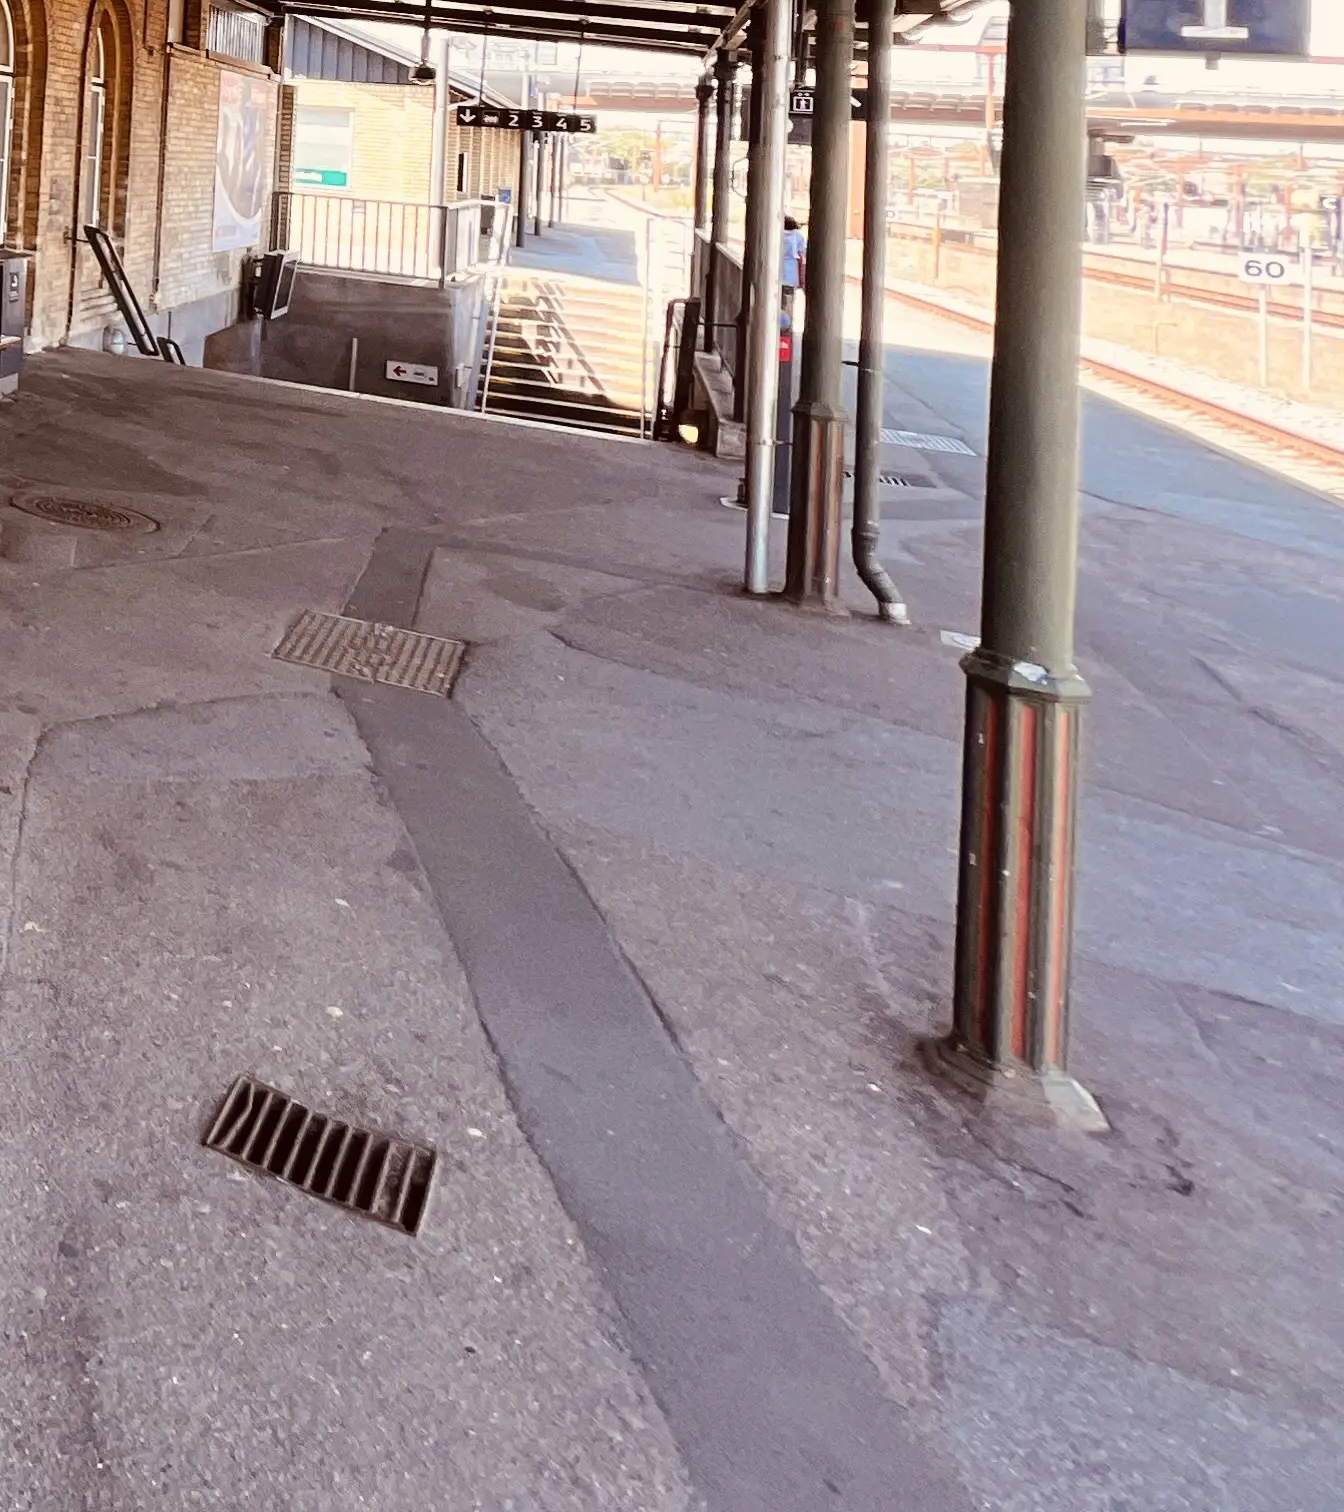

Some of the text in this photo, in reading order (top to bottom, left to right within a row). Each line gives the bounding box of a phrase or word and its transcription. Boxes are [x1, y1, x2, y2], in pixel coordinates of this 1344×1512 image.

[508, 114, 591, 131] 2 3 4 5
[1245, 260, 1285, 278] 60
